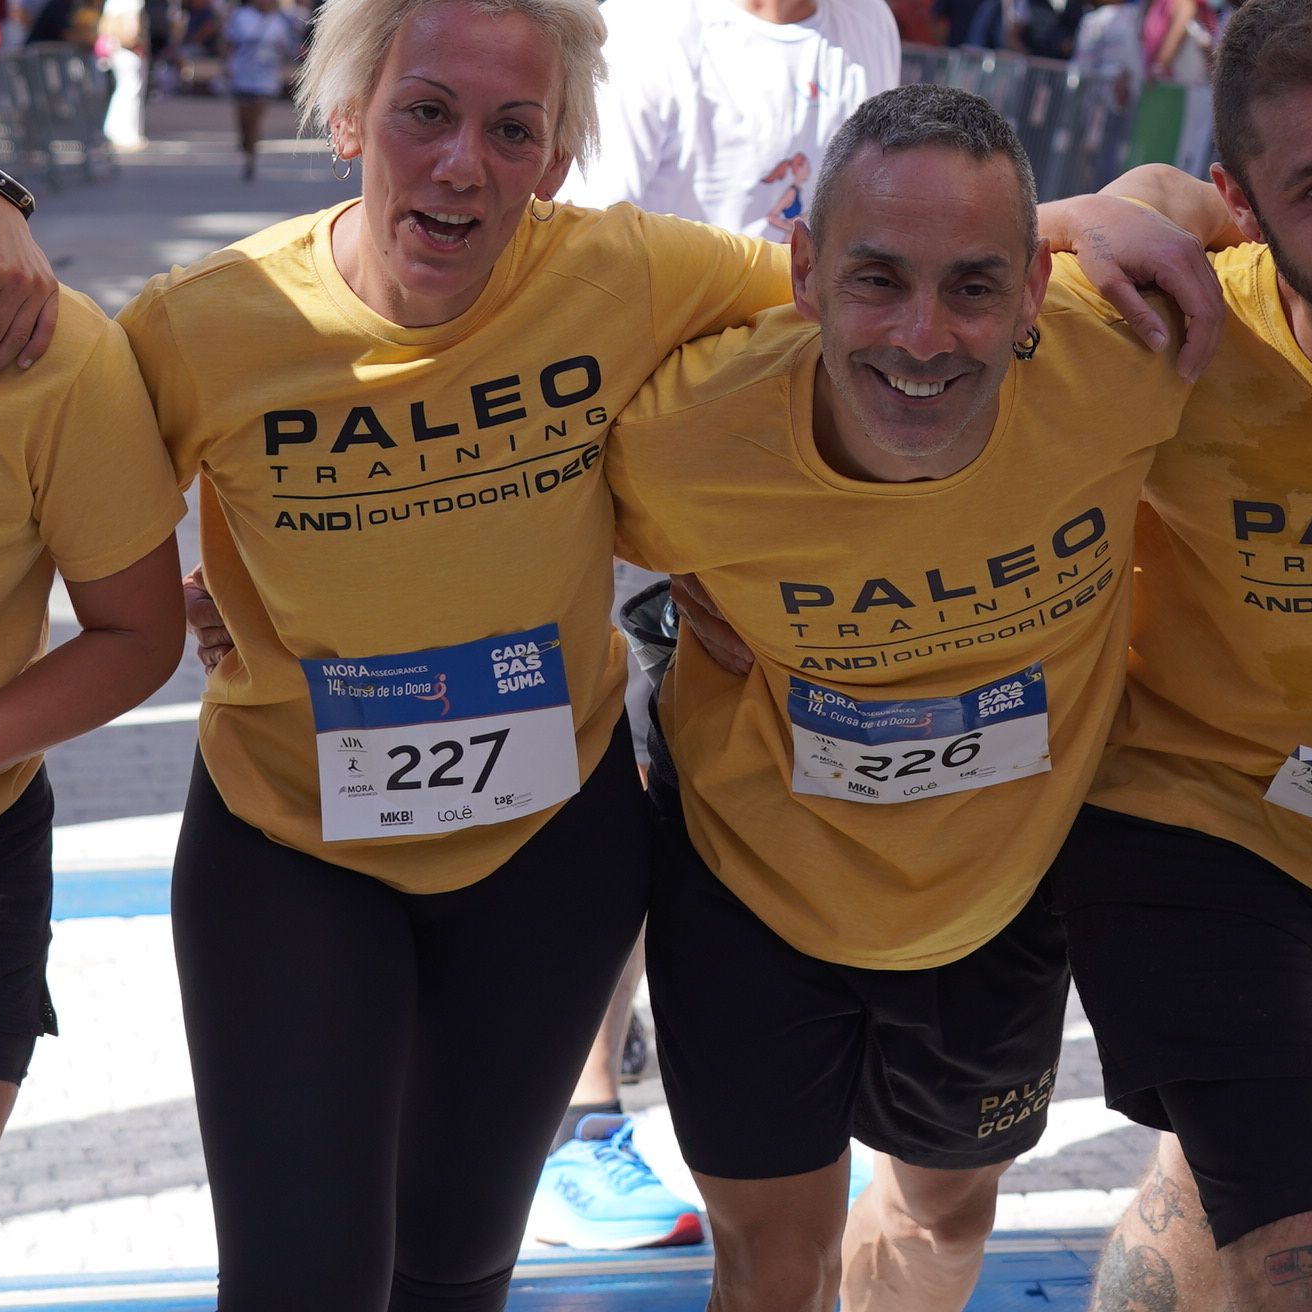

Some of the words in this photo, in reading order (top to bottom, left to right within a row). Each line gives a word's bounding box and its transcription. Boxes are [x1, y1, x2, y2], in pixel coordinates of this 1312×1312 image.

[264, 355, 602, 456] PALEO
[270, 406, 609, 484] TRAINING
[779, 506, 1106, 615] PALEO
[790, 540, 1110, 638] TRAINING
[491, 641, 540, 662] CADA
[322, 664, 370, 678] MORA
[370, 665, 429, 677] ASSEGURANCES
[493, 654, 542, 679] PAS
[377, 685, 389, 698] de
[392, 686, 403, 697] la
[405, 682, 432, 696] Dona
[497, 671, 546, 694] SUMA
[978, 681, 1024, 701] CADA
[809, 689, 858, 713] MORA
[978, 688, 1025, 710] PAS
[979, 698, 1025, 718] SUMA
[830, 711, 859, 726] Cursa
[889, 717, 917, 726] Dona
[386, 727, 511, 793] 227
[854, 732, 984, 782] 226
[348, 784, 375, 793] MORA
[380, 810, 414, 823] MKB!
